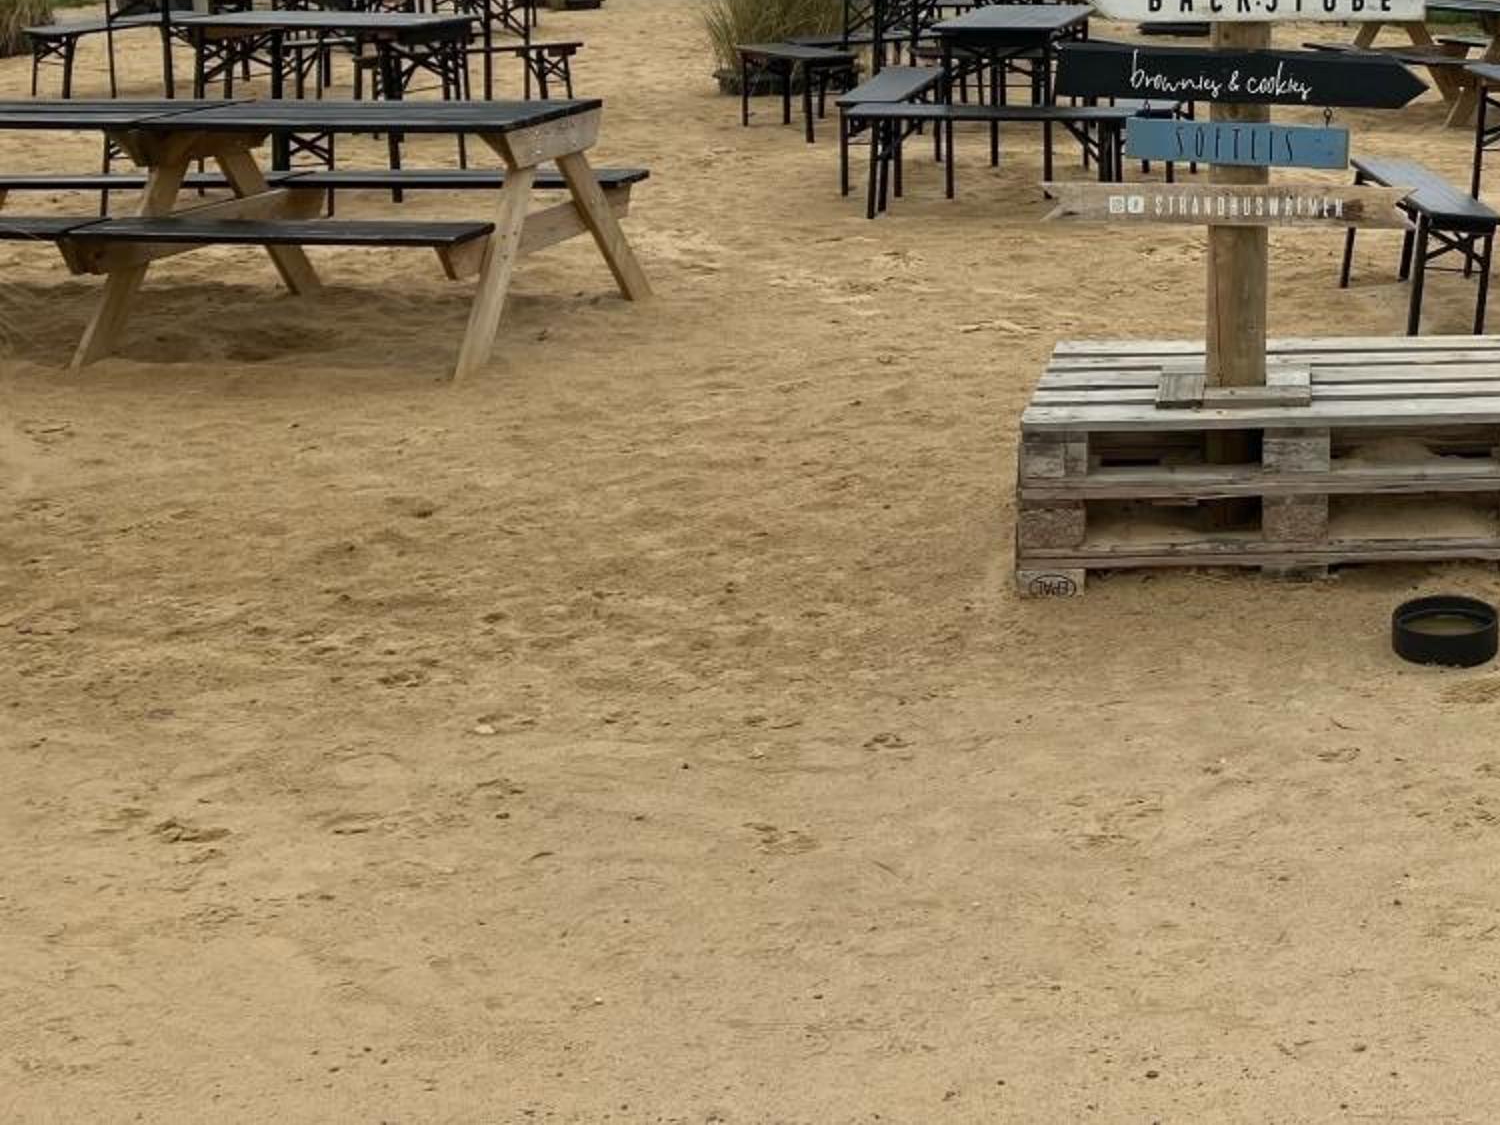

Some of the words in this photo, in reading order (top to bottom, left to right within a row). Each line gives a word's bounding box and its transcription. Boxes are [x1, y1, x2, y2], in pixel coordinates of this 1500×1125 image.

[1130, 48, 1223, 98] brownies
[1227, 69, 1241, 92] &
[1246, 60, 1312, 101] cookies
